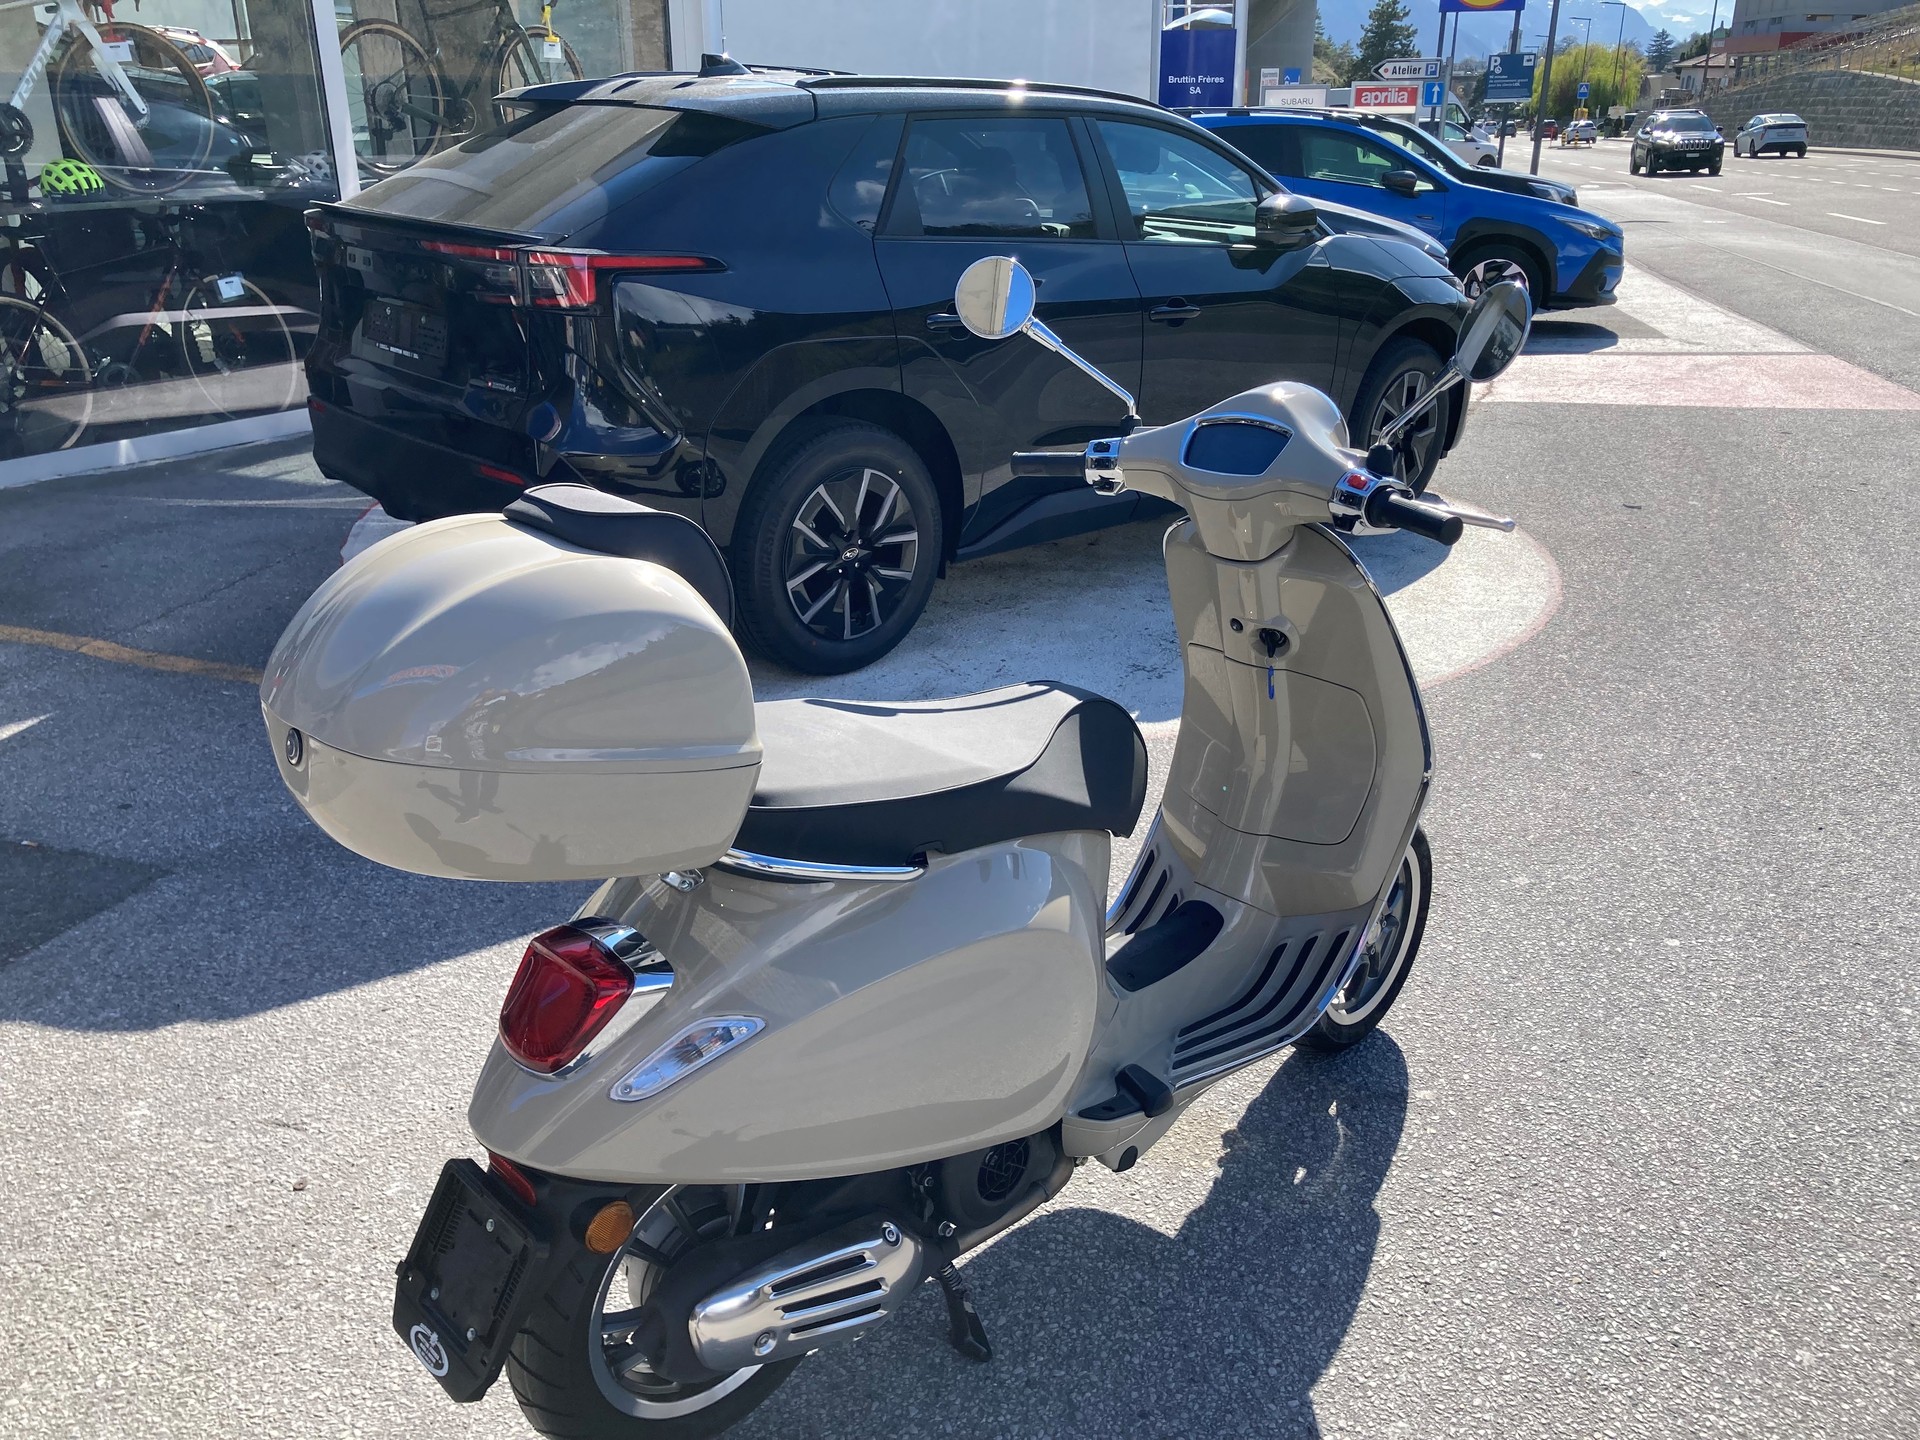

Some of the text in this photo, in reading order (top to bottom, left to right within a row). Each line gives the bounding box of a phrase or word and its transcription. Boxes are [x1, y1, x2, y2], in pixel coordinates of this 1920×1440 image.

[1392, 65, 1422, 75] Atelier
[1168, 75, 1225, 84] Bruttin Frères
[1189, 86, 1202, 95] SA
[1280, 97, 1314, 106] SUBARU
[1360, 87, 1409, 107] aprilia
